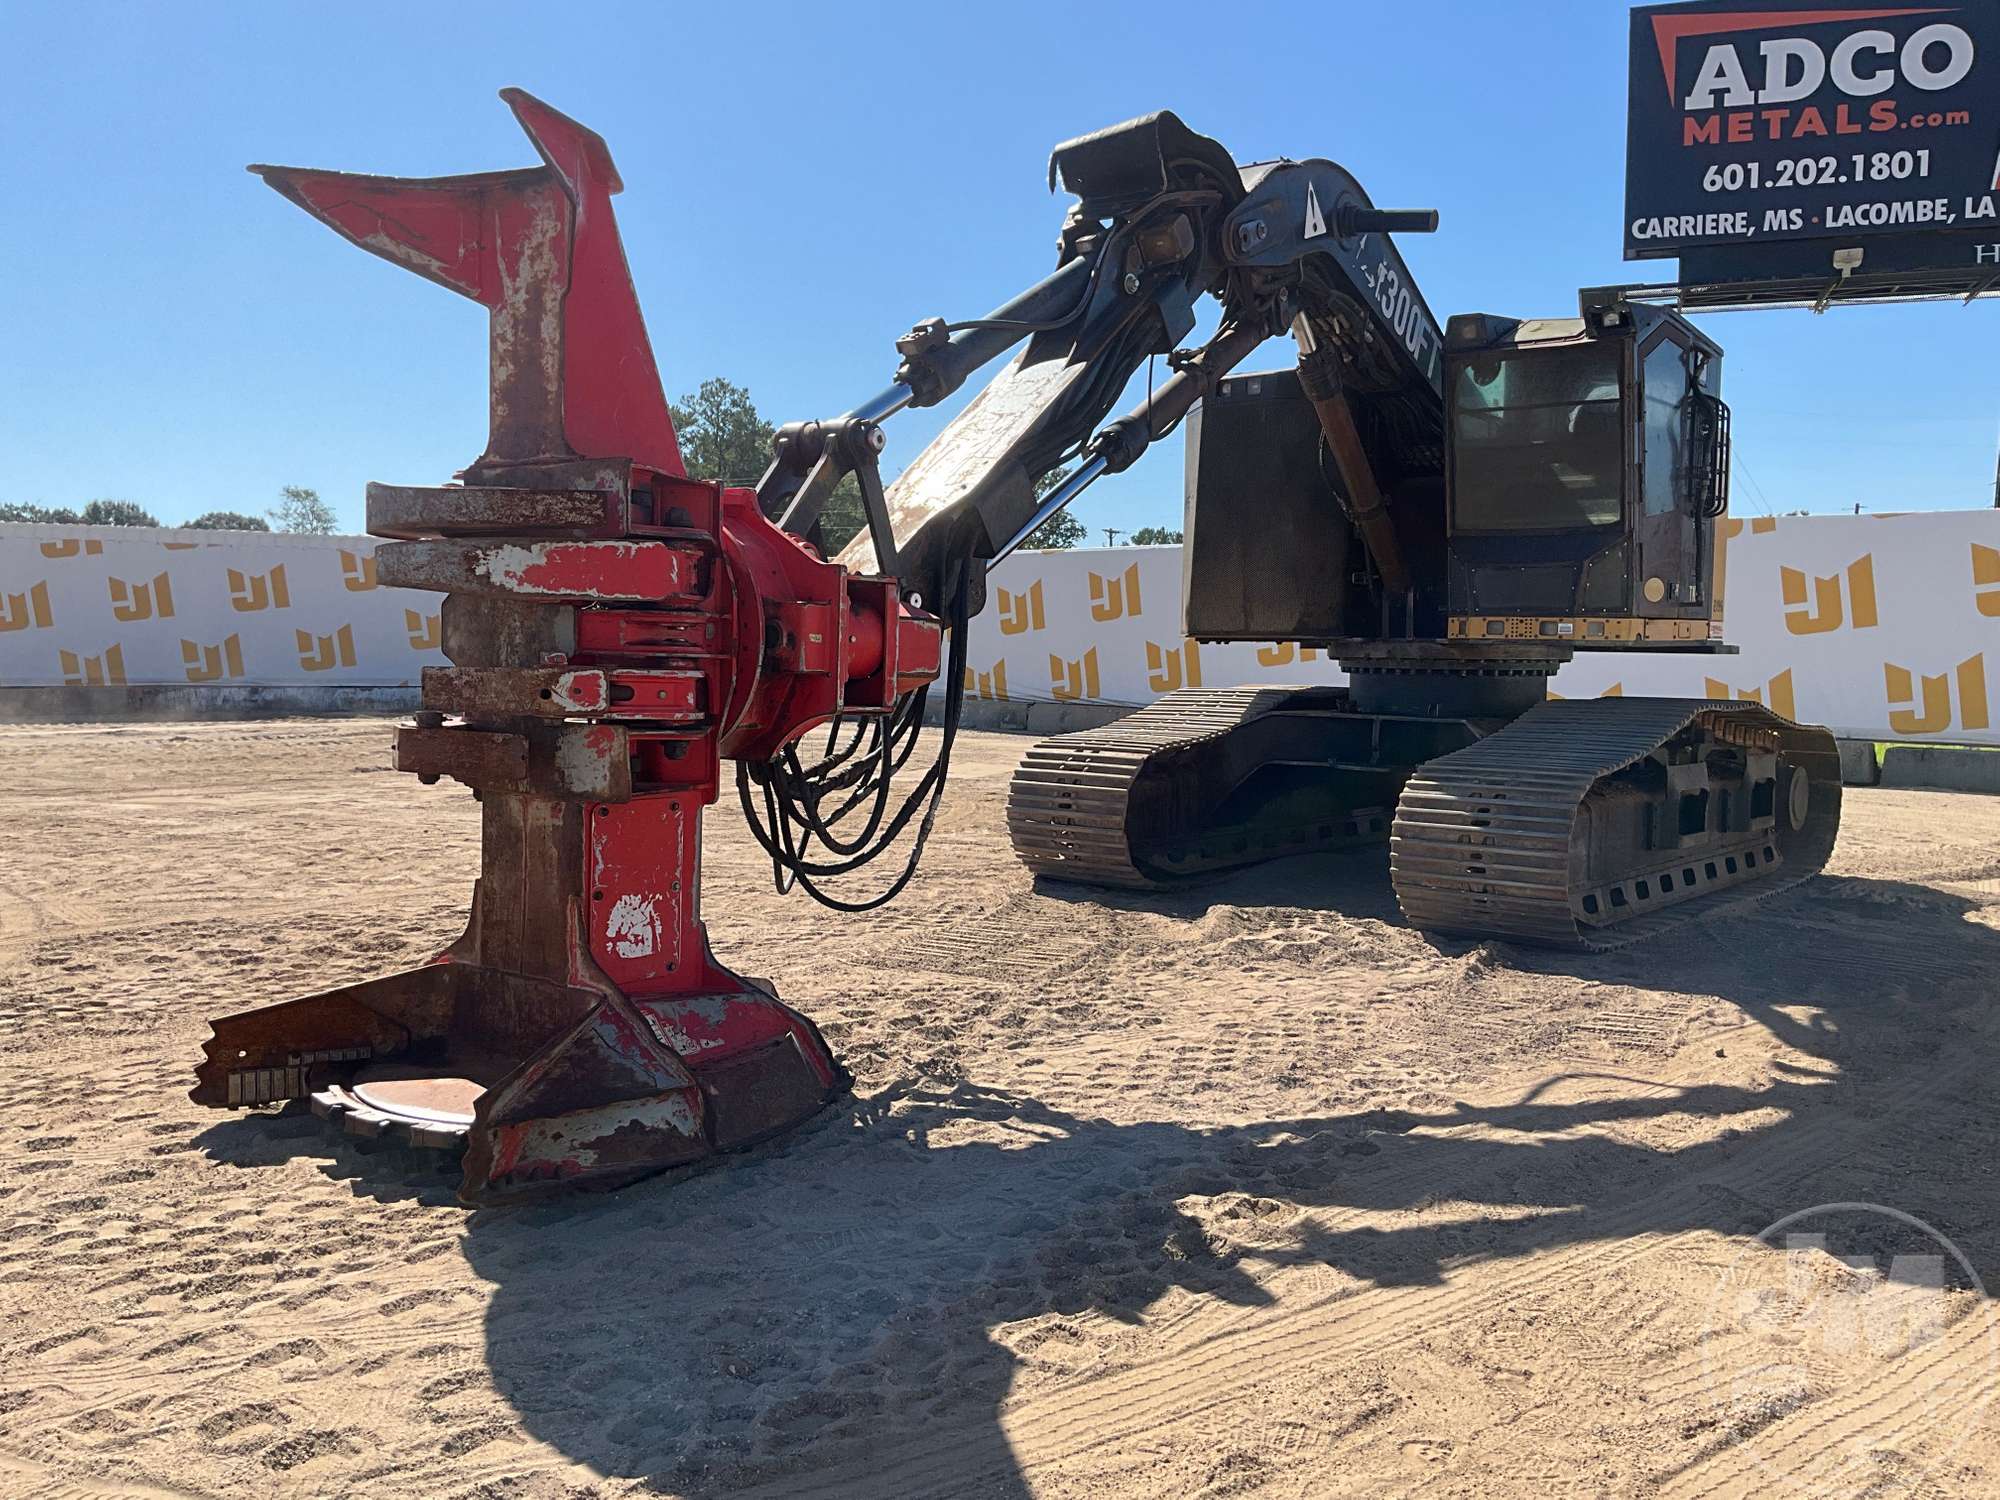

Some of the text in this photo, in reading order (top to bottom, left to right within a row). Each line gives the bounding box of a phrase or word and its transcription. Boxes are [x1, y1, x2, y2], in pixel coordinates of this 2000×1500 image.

[1684, 23, 1975, 111] ADCO
[1682, 100, 1970, 147] METALS.com
[1702, 149, 1931, 193] 601.202.1801
[1631, 195, 1997, 238] CARRIERE, MS LACOMBE, LA
